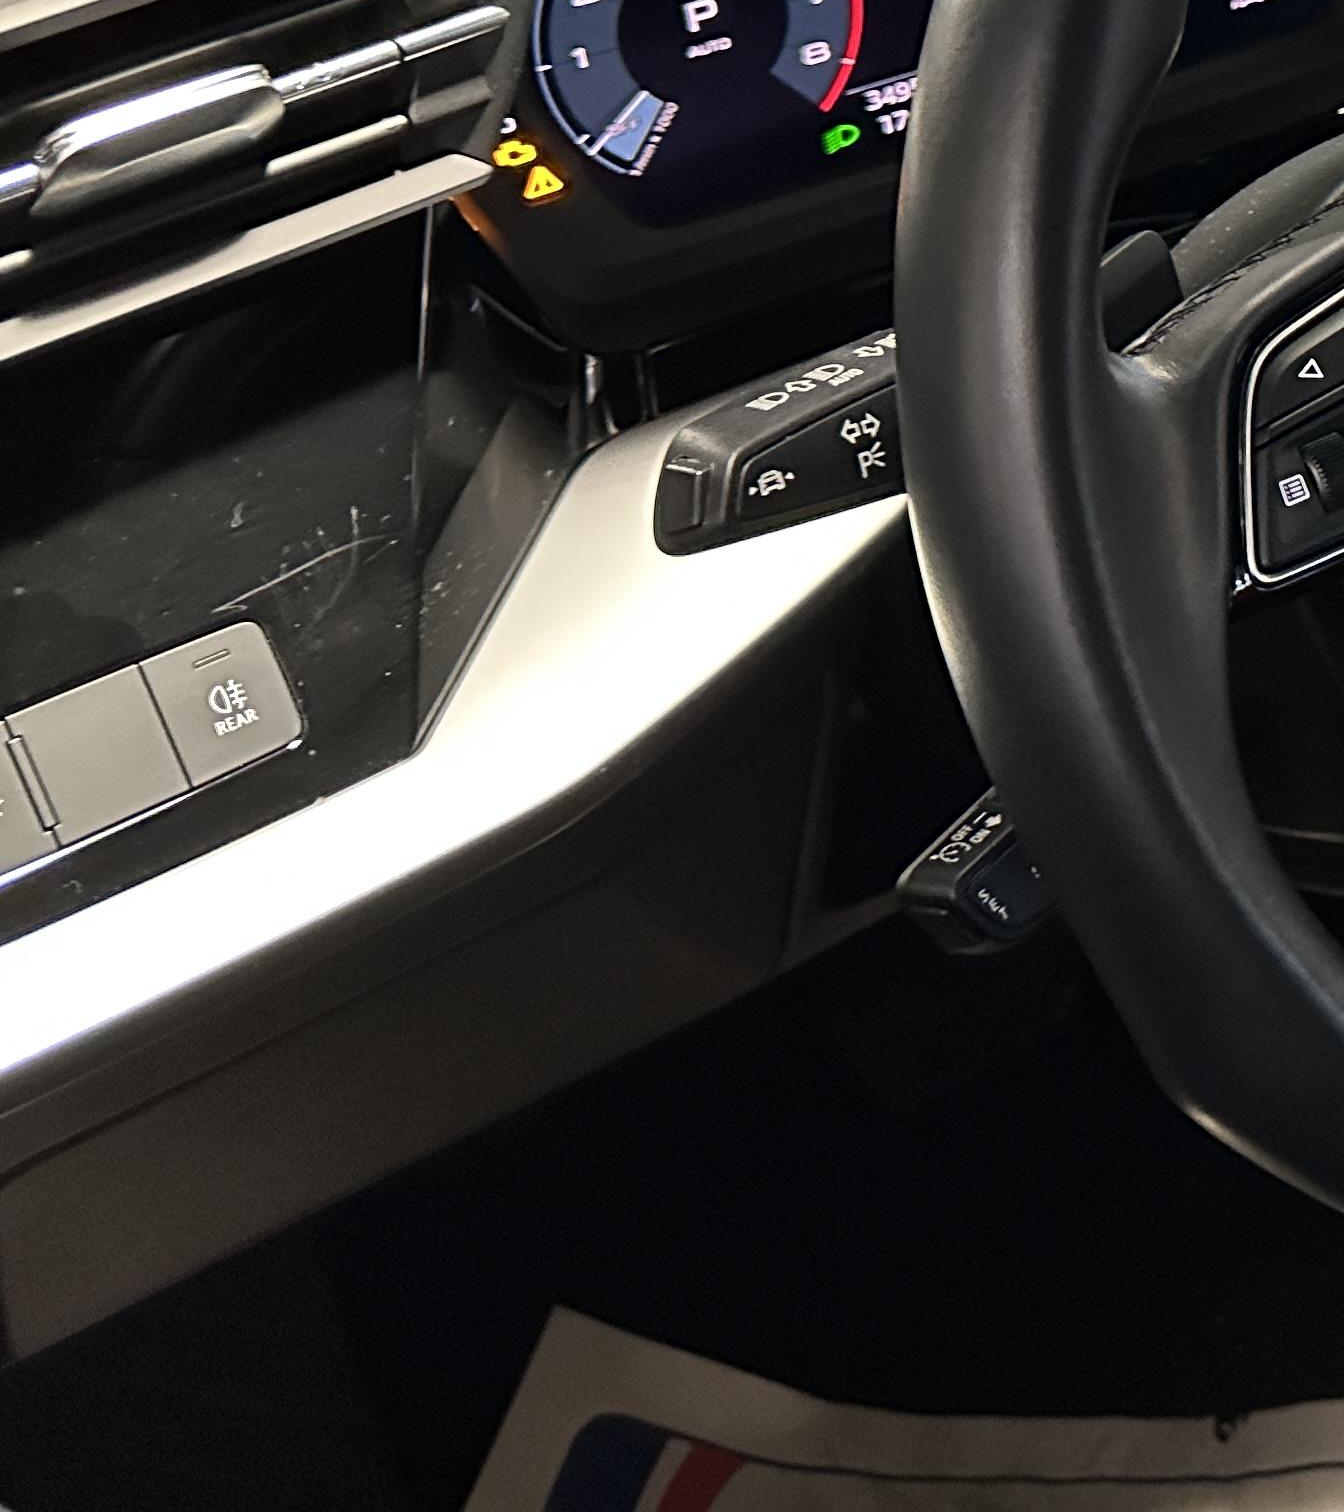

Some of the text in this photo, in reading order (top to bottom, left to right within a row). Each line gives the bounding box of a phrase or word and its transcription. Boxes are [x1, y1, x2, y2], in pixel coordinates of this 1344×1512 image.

[568, 47, 590, 69] 1
[800, 42, 832, 65] 8
[214, 709, 259, 736] REAR
[978, 889, 1008, 919] SET
